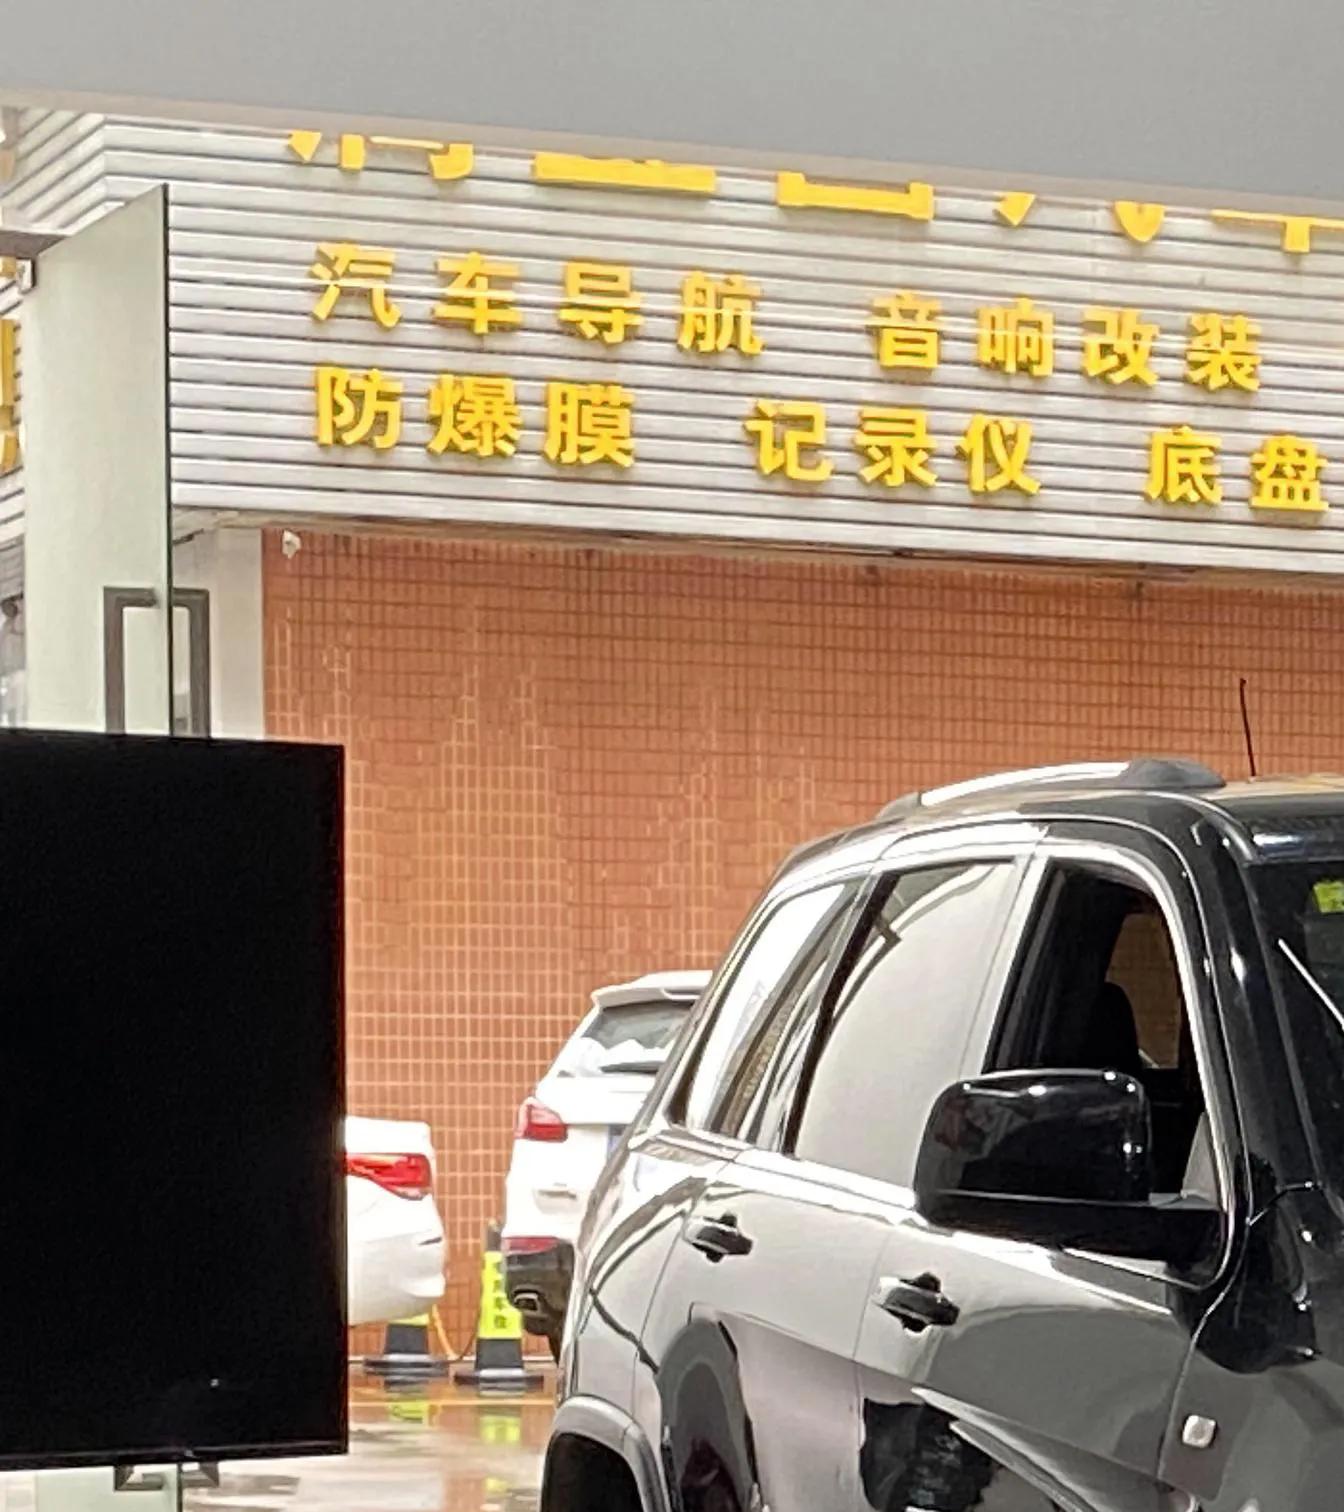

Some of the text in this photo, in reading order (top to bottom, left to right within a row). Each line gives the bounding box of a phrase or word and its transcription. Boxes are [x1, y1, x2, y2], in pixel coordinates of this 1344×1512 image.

[312, 241, 1262, 394] 汽车导航 音响改装
[312, 363, 636, 470] 防爆膜
[744, 404, 1041, 496] 记录仪
